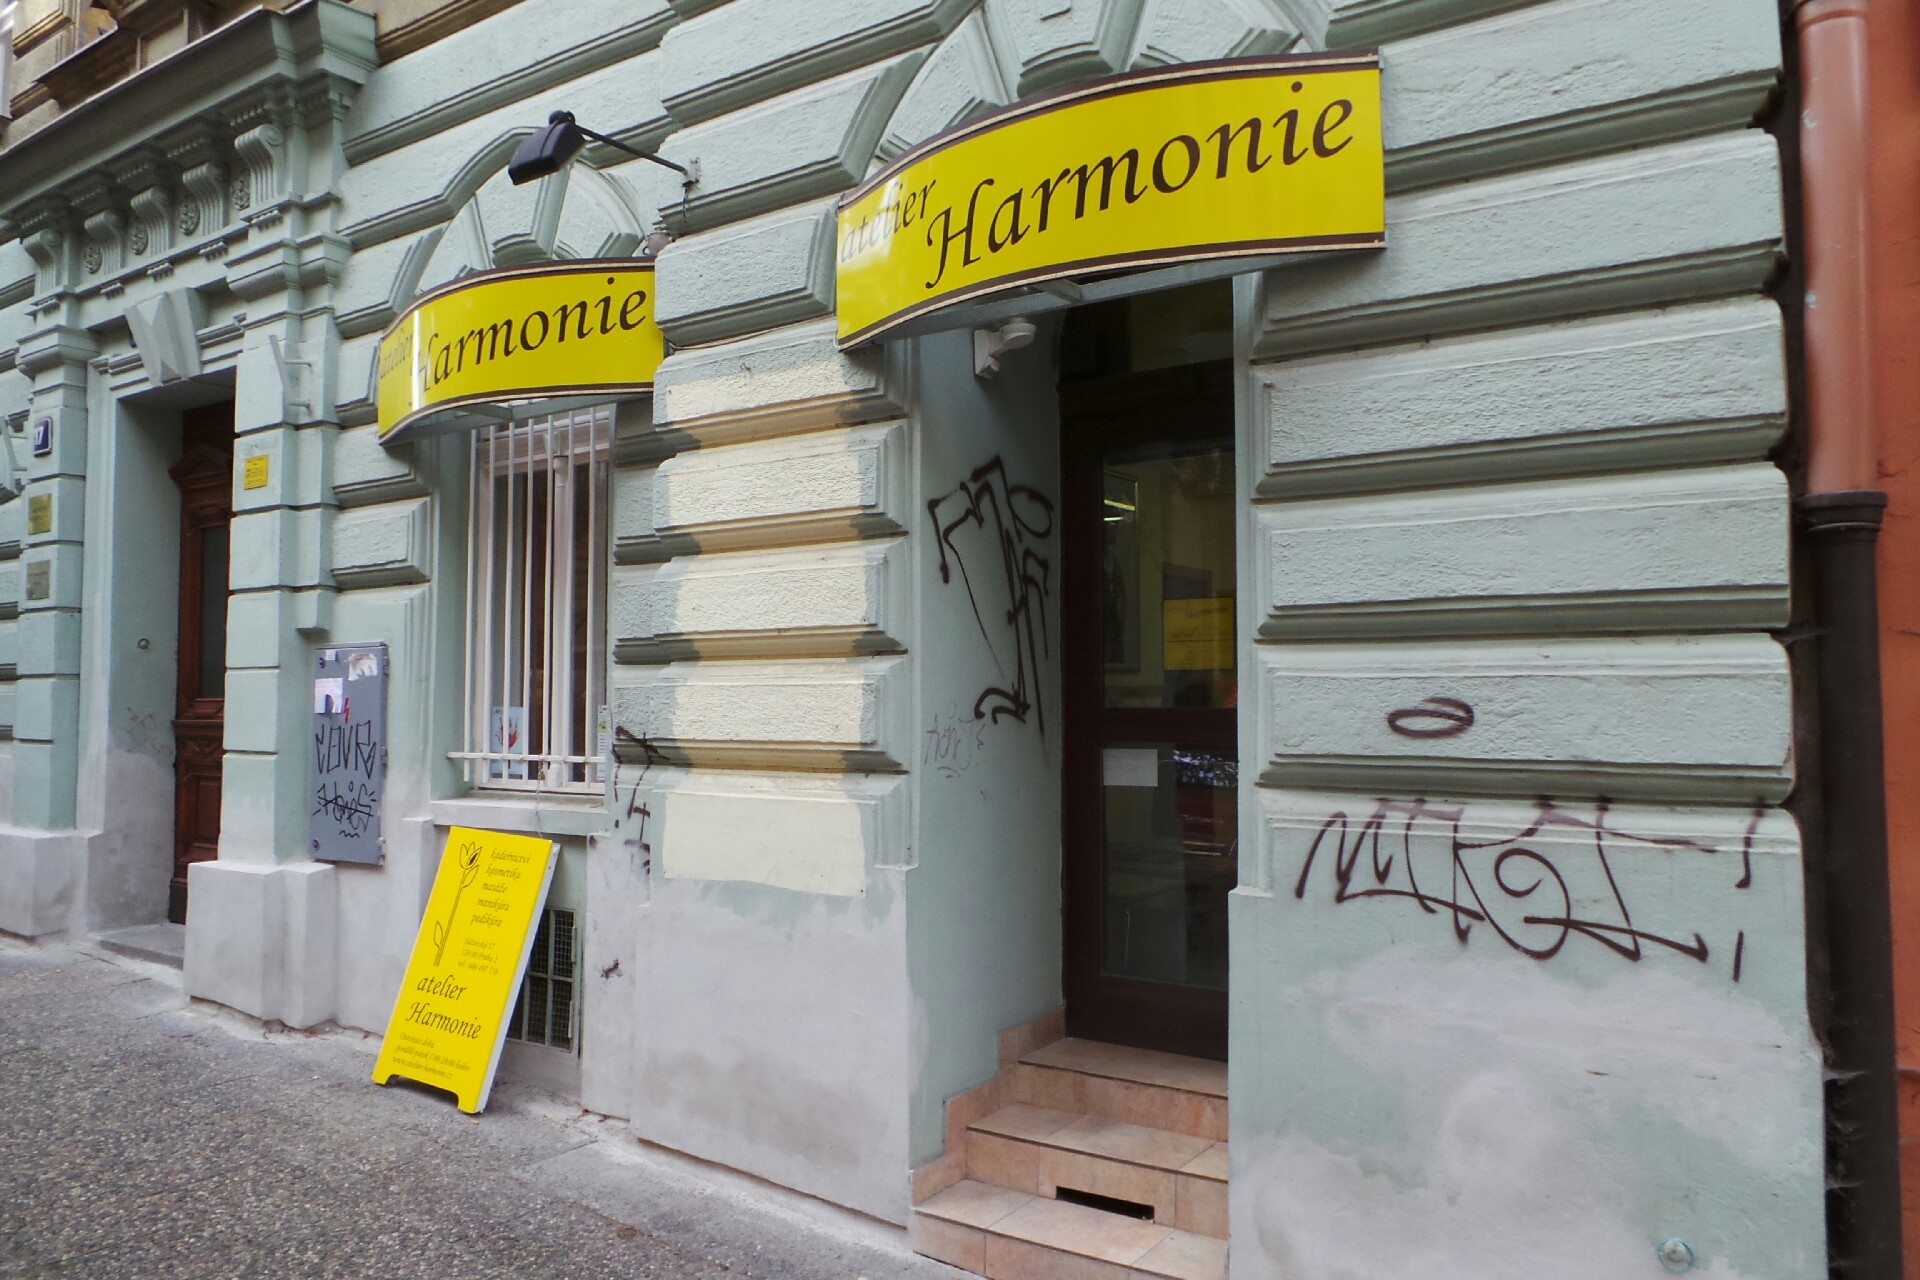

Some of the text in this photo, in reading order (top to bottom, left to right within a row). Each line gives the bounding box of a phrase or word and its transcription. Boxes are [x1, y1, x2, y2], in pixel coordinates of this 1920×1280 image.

[925, 80, 1353, 289] Harmonie
[841, 179, 936, 263] atelier
[417, 975, 467, 1001] atelier
[405, 1002, 482, 1040] Harmonie
